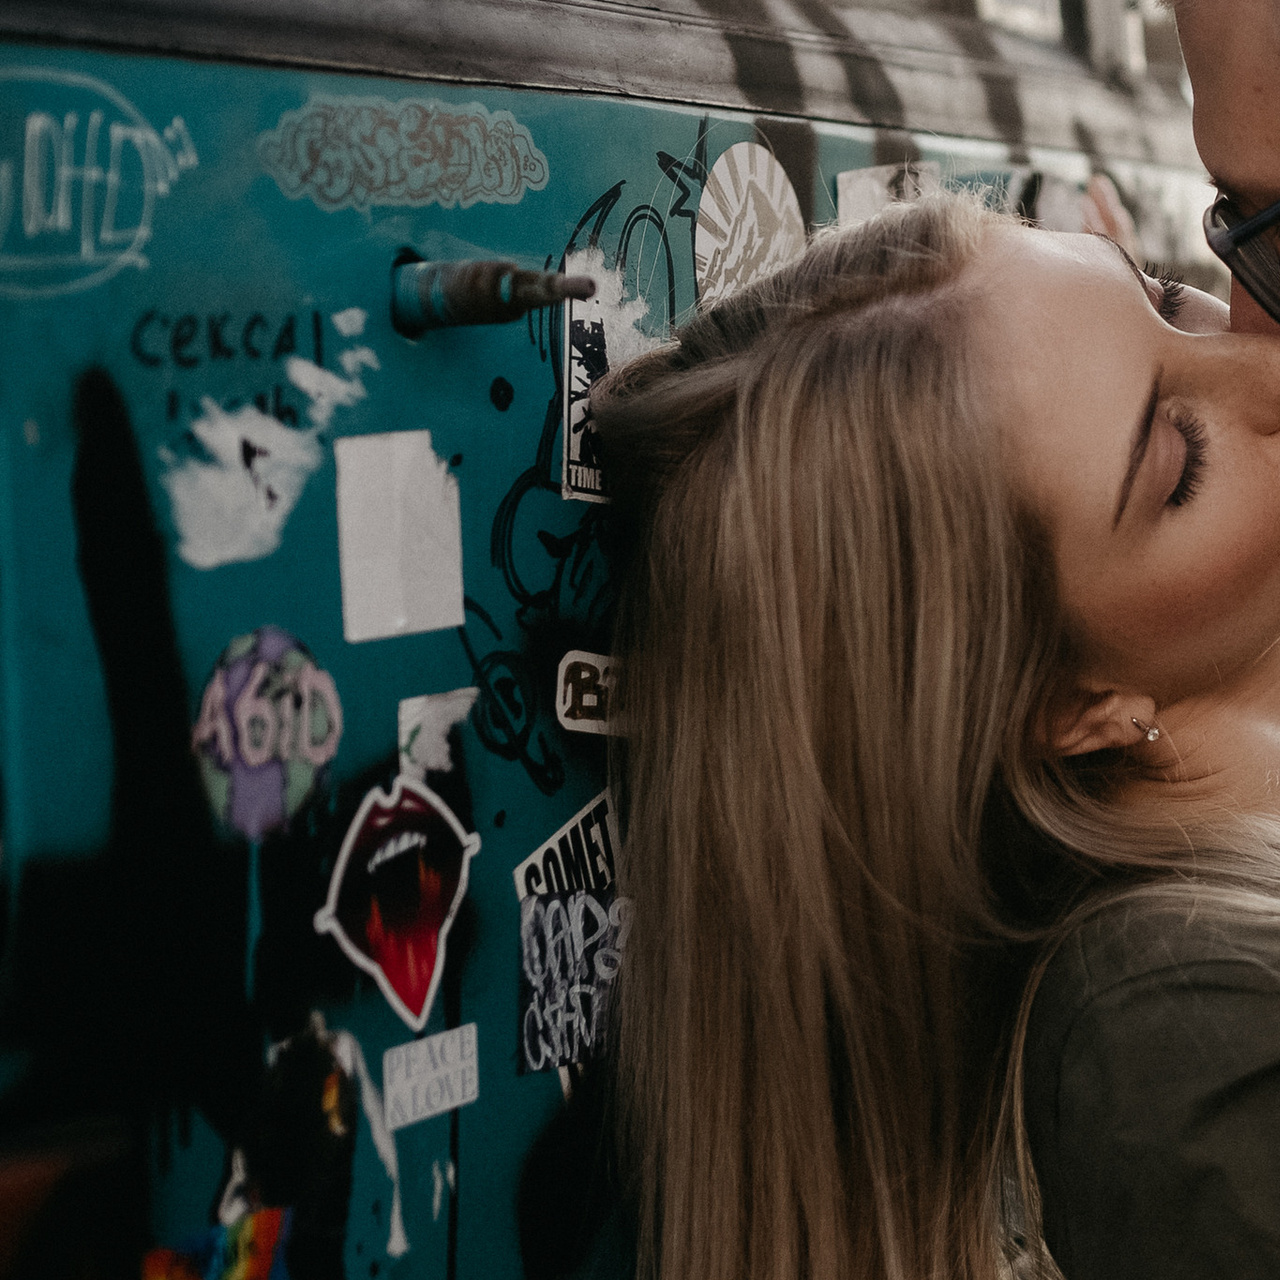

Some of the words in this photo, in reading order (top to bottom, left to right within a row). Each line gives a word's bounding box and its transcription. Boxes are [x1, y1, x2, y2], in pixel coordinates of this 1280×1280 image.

[569, 464, 603, 492] TIME
[388, 1026, 475, 1085] PEACE
[411, 1066, 477, 1118] LOVE
